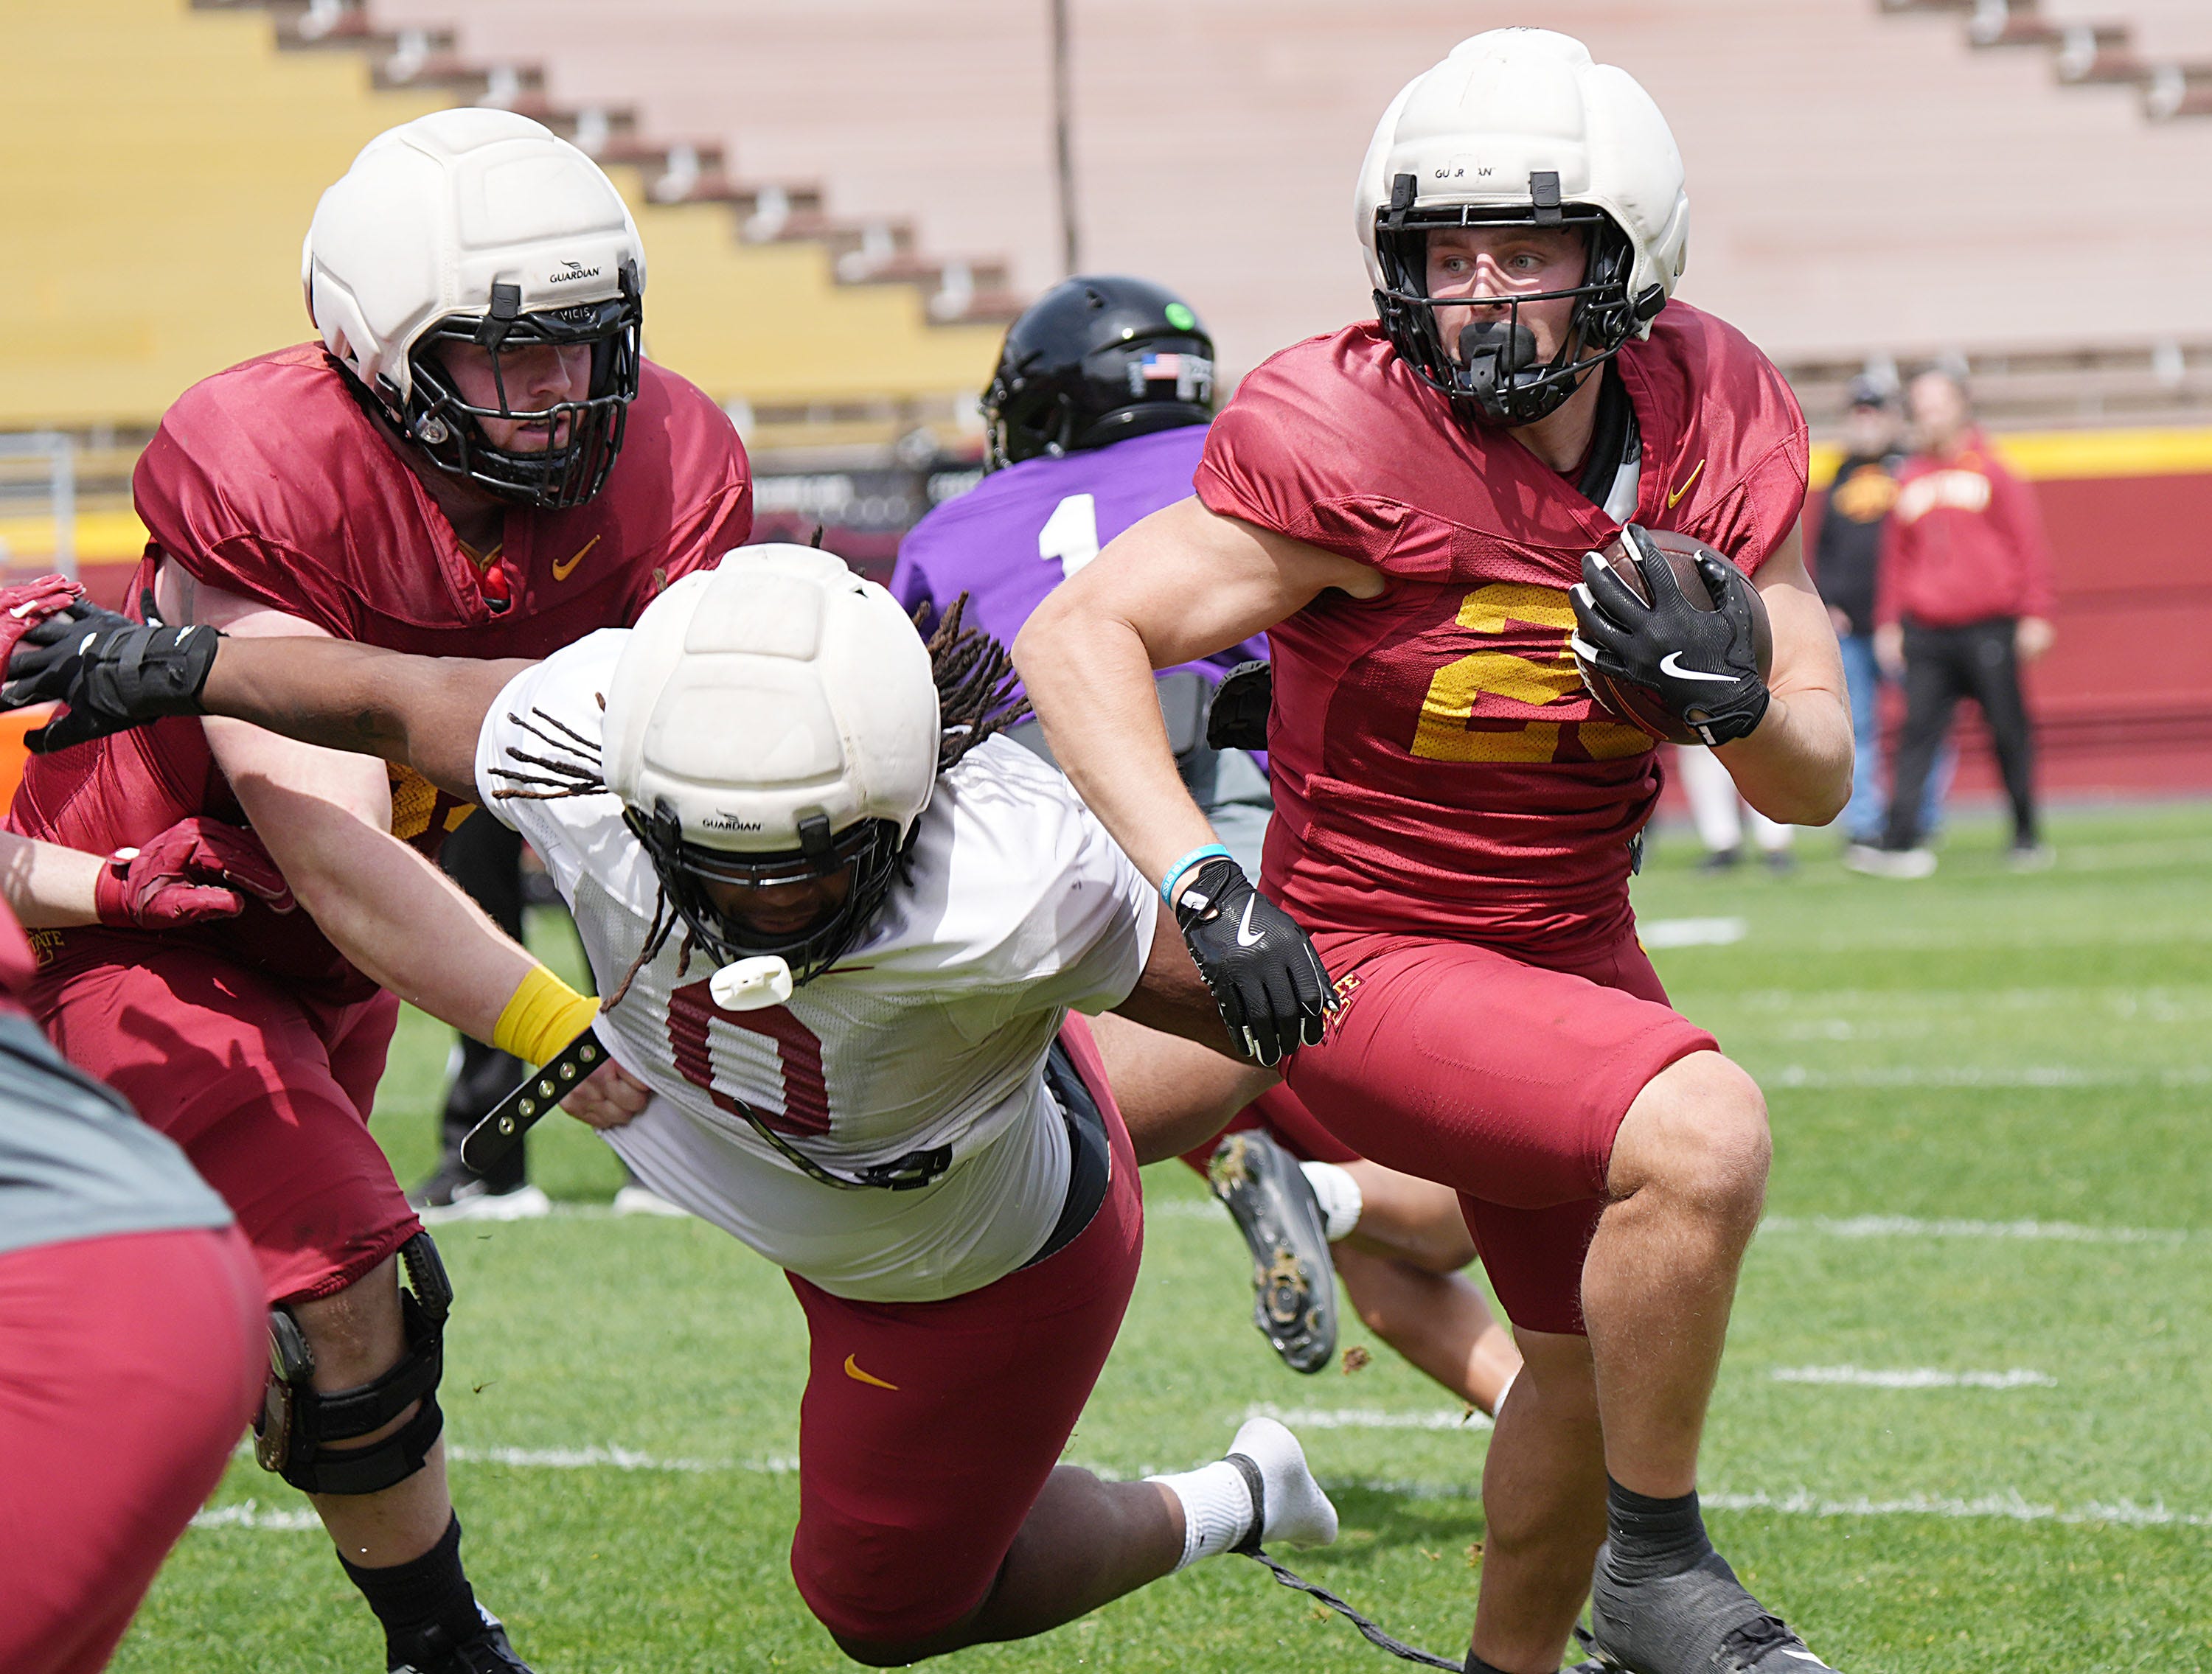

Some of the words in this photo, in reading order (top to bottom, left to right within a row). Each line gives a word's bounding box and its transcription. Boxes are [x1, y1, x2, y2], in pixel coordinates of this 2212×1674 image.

[549, 267, 599, 283] GUARDIAN
[560, 307, 590, 321] VICIS
[703, 818, 762, 831] GUARDIAN
[665, 976, 832, 1137] 0
